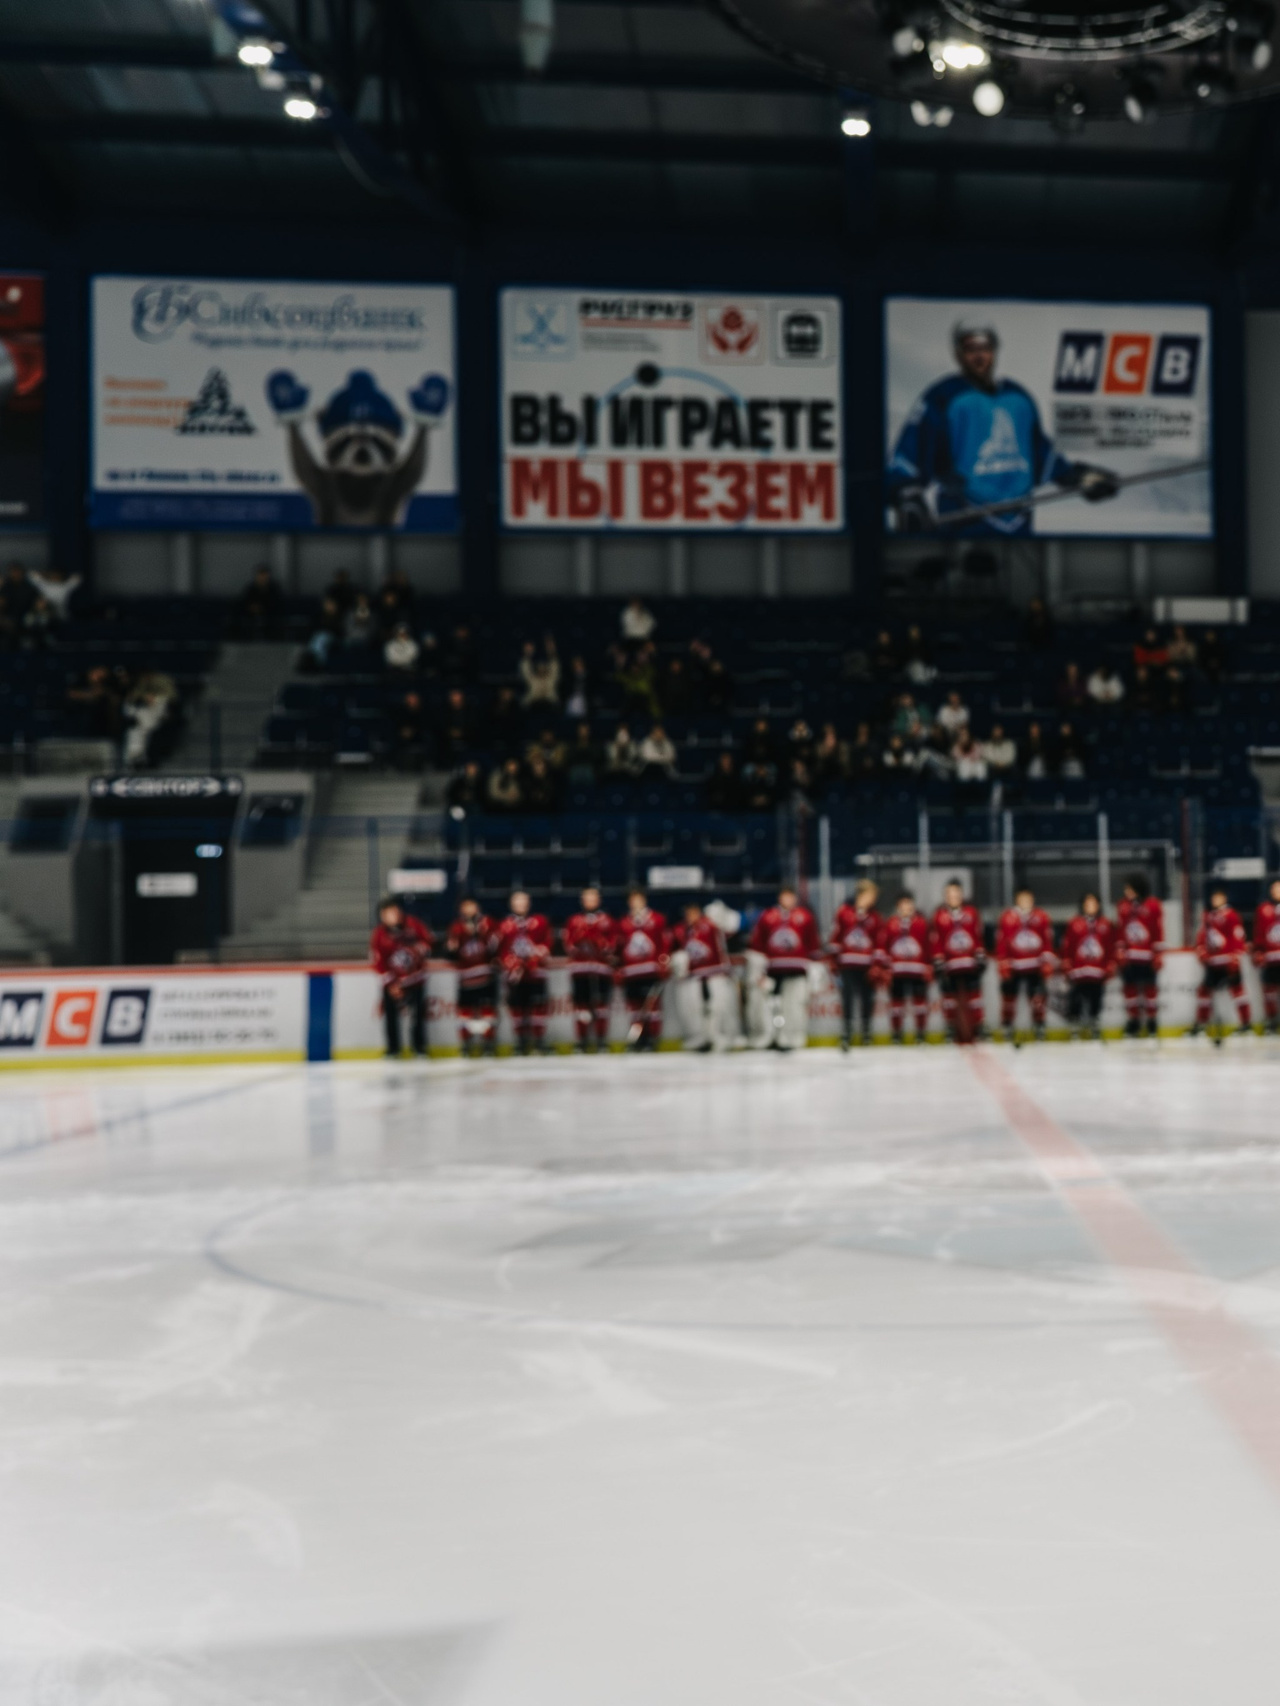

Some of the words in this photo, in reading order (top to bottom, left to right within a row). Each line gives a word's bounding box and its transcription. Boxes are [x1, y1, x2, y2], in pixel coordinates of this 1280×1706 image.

[511, 395, 598, 448] ВЫ
[610, 397, 835, 451] ИГРАЕТЕ
[511, 458, 626, 520] МЫ
[640, 460, 837, 522] ВЕЗЕМ
